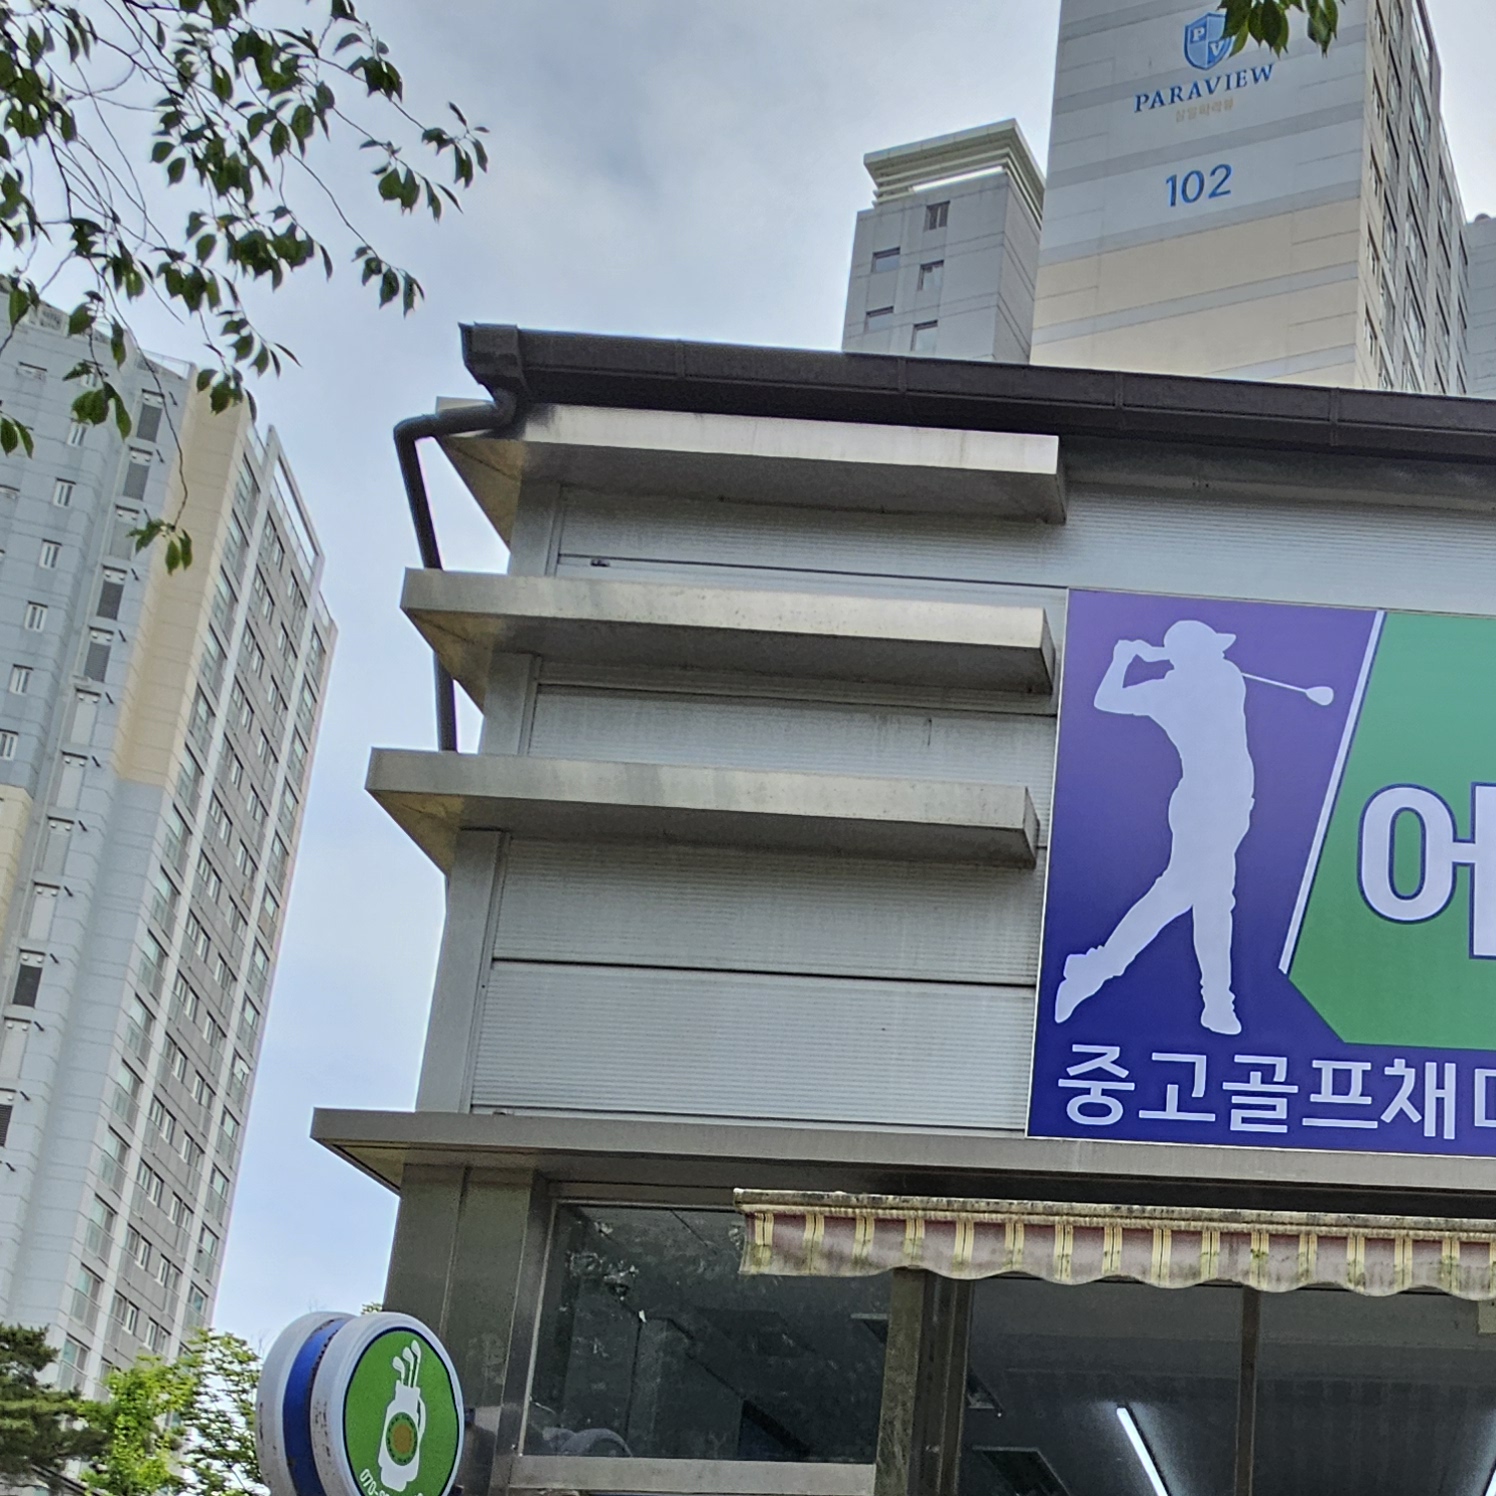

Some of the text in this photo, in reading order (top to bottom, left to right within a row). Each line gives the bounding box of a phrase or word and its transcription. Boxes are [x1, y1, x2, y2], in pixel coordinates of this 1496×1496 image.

[1134, 63, 1275, 113] PARAVIEW
[1165, 163, 1233, 207] 102
[1057, 1043, 1456, 1140] 중고골프채
